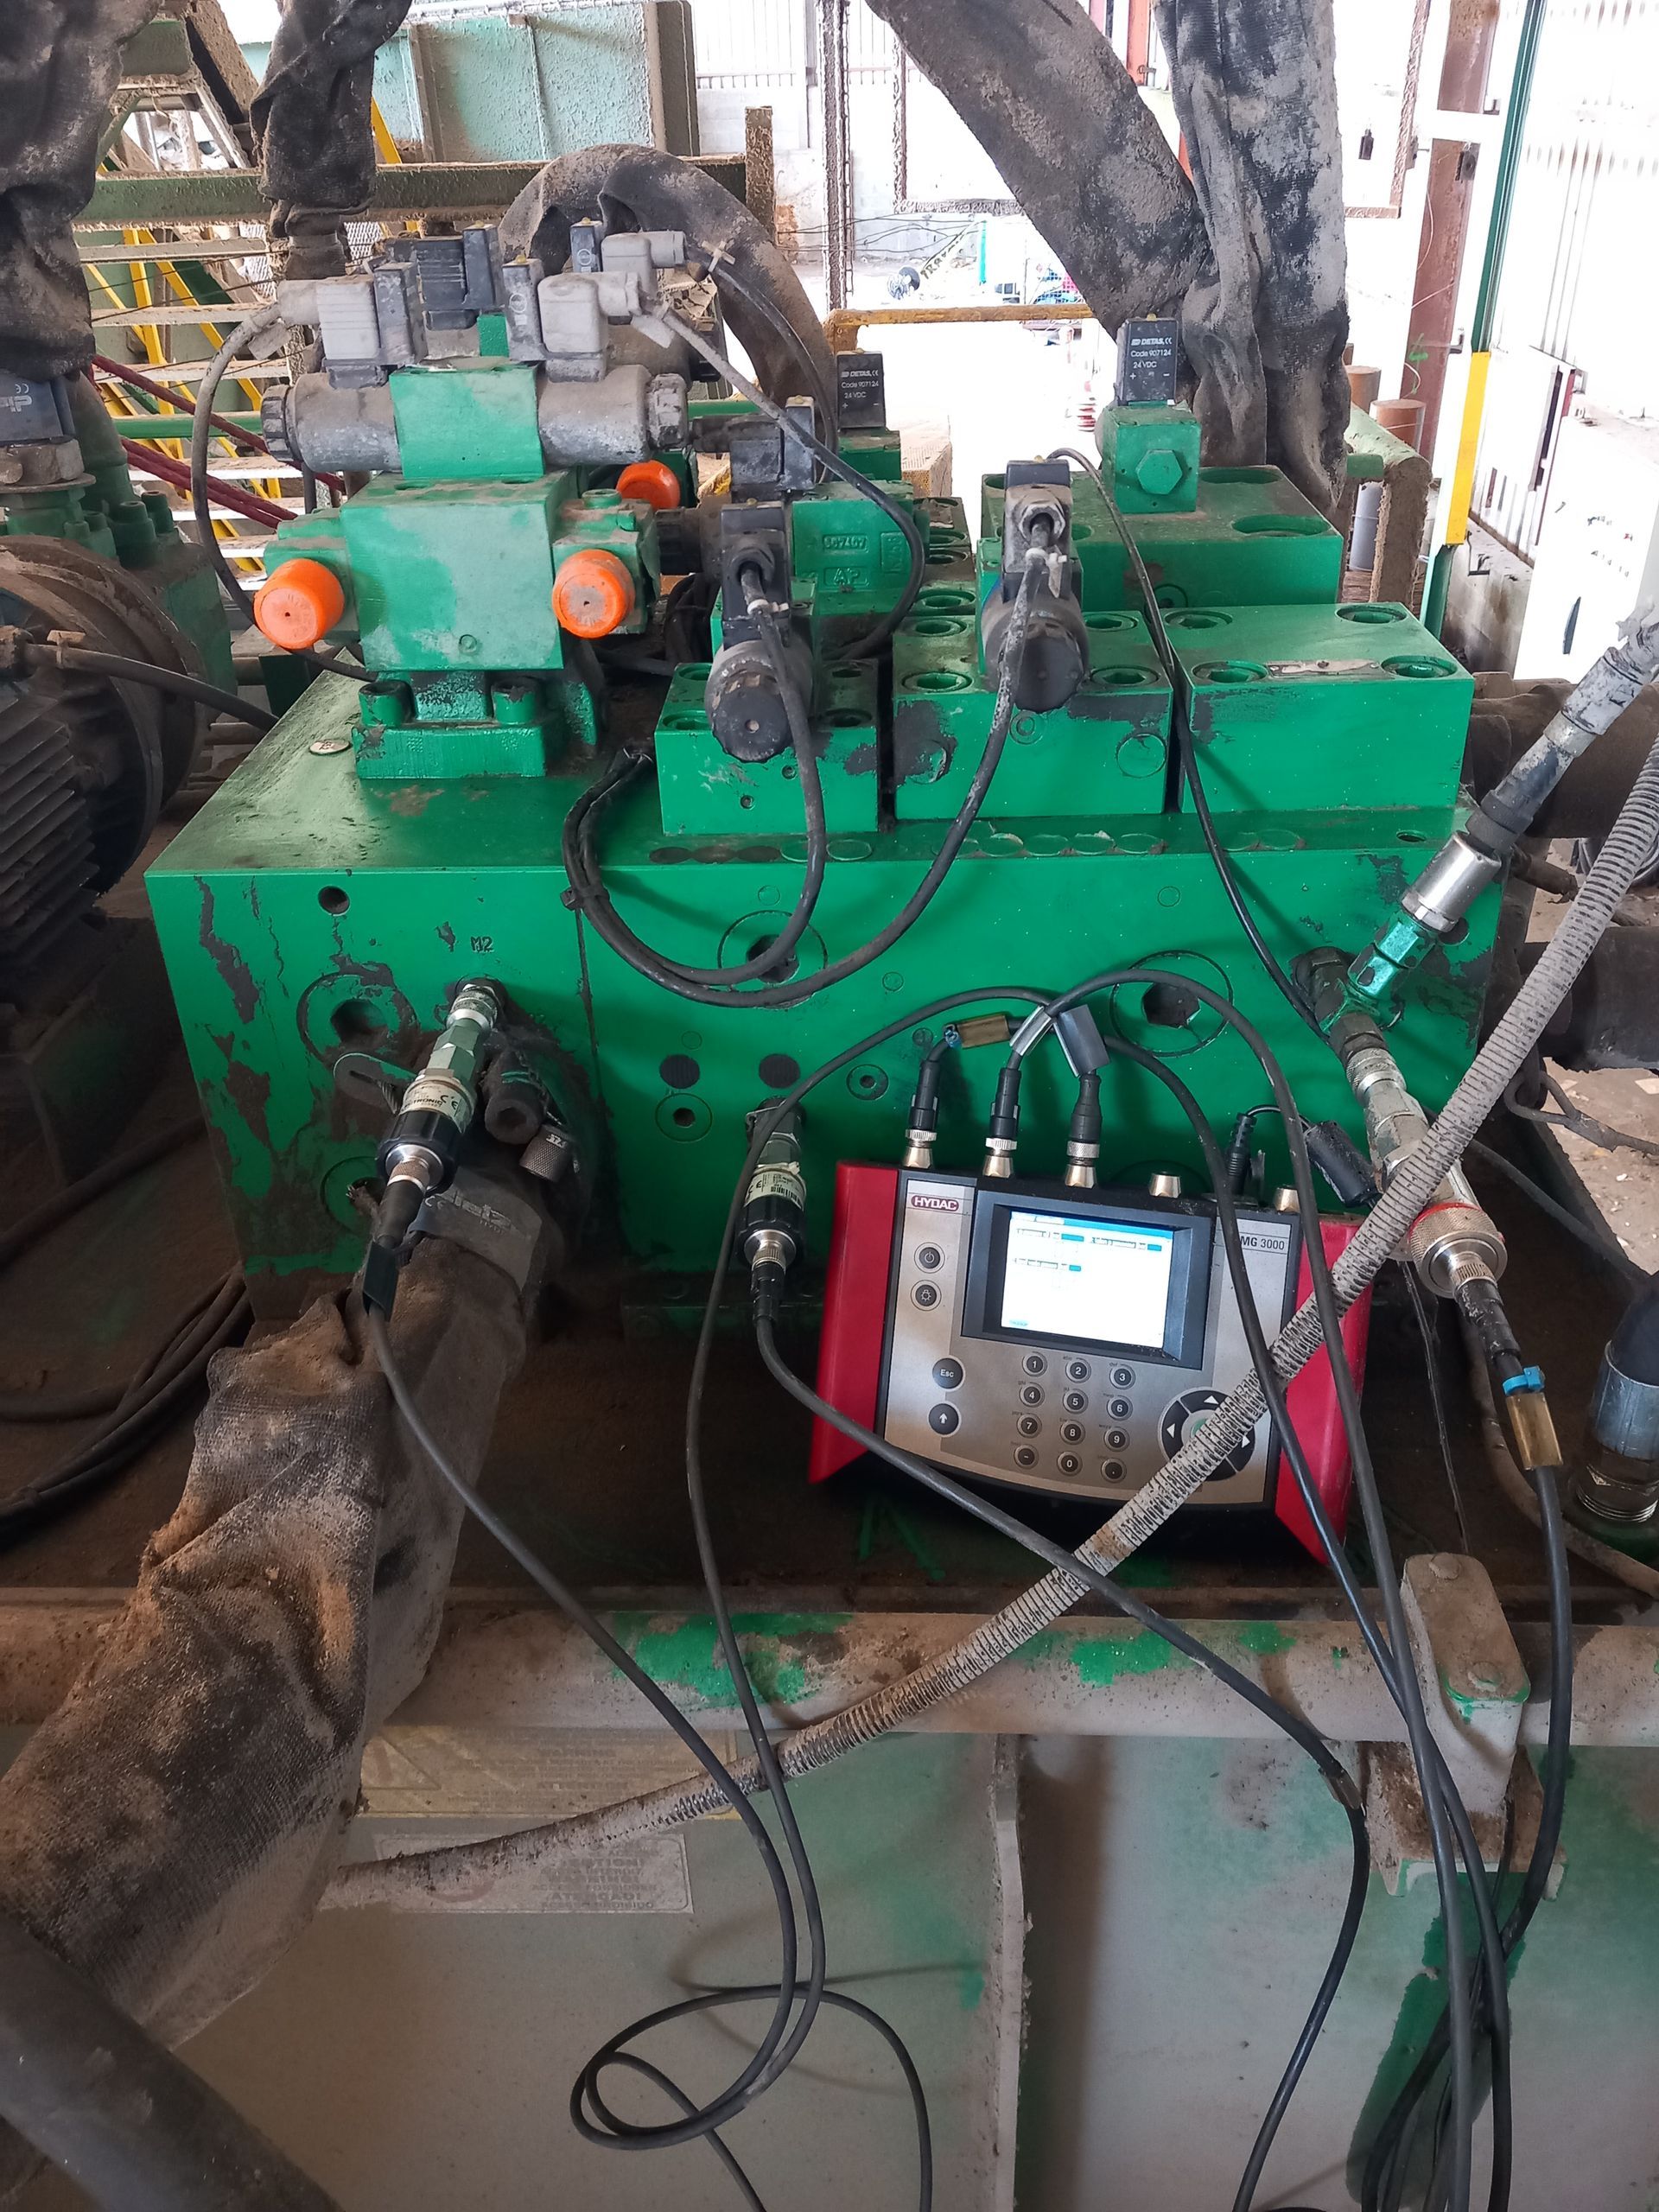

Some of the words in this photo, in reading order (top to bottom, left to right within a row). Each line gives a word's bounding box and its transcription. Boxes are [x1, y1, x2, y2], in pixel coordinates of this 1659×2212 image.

[470, 936, 494, 953] M2
[913, 1196, 957, 1211] HYDAC
[1240, 1236, 1257, 1247] MG
[1260, 1238, 1285, 1250] 3000
[940, 1369, 955, 1377] Esc
[1075, 1366, 1082, 1375] 2
[1119, 1373, 1126, 1382] 3
[1028, 1391, 1035, 1400] 4
[1072, 1397, 1078, 1406] 5
[1116, 1404, 1123, 1413] 6
[1027, 1421, 1033, 1430] 7
[1070, 1428, 1076, 1437] 8
[1113, 1435, 1120, 1444] 9
[1066, 1459, 1072, 1468] 0
